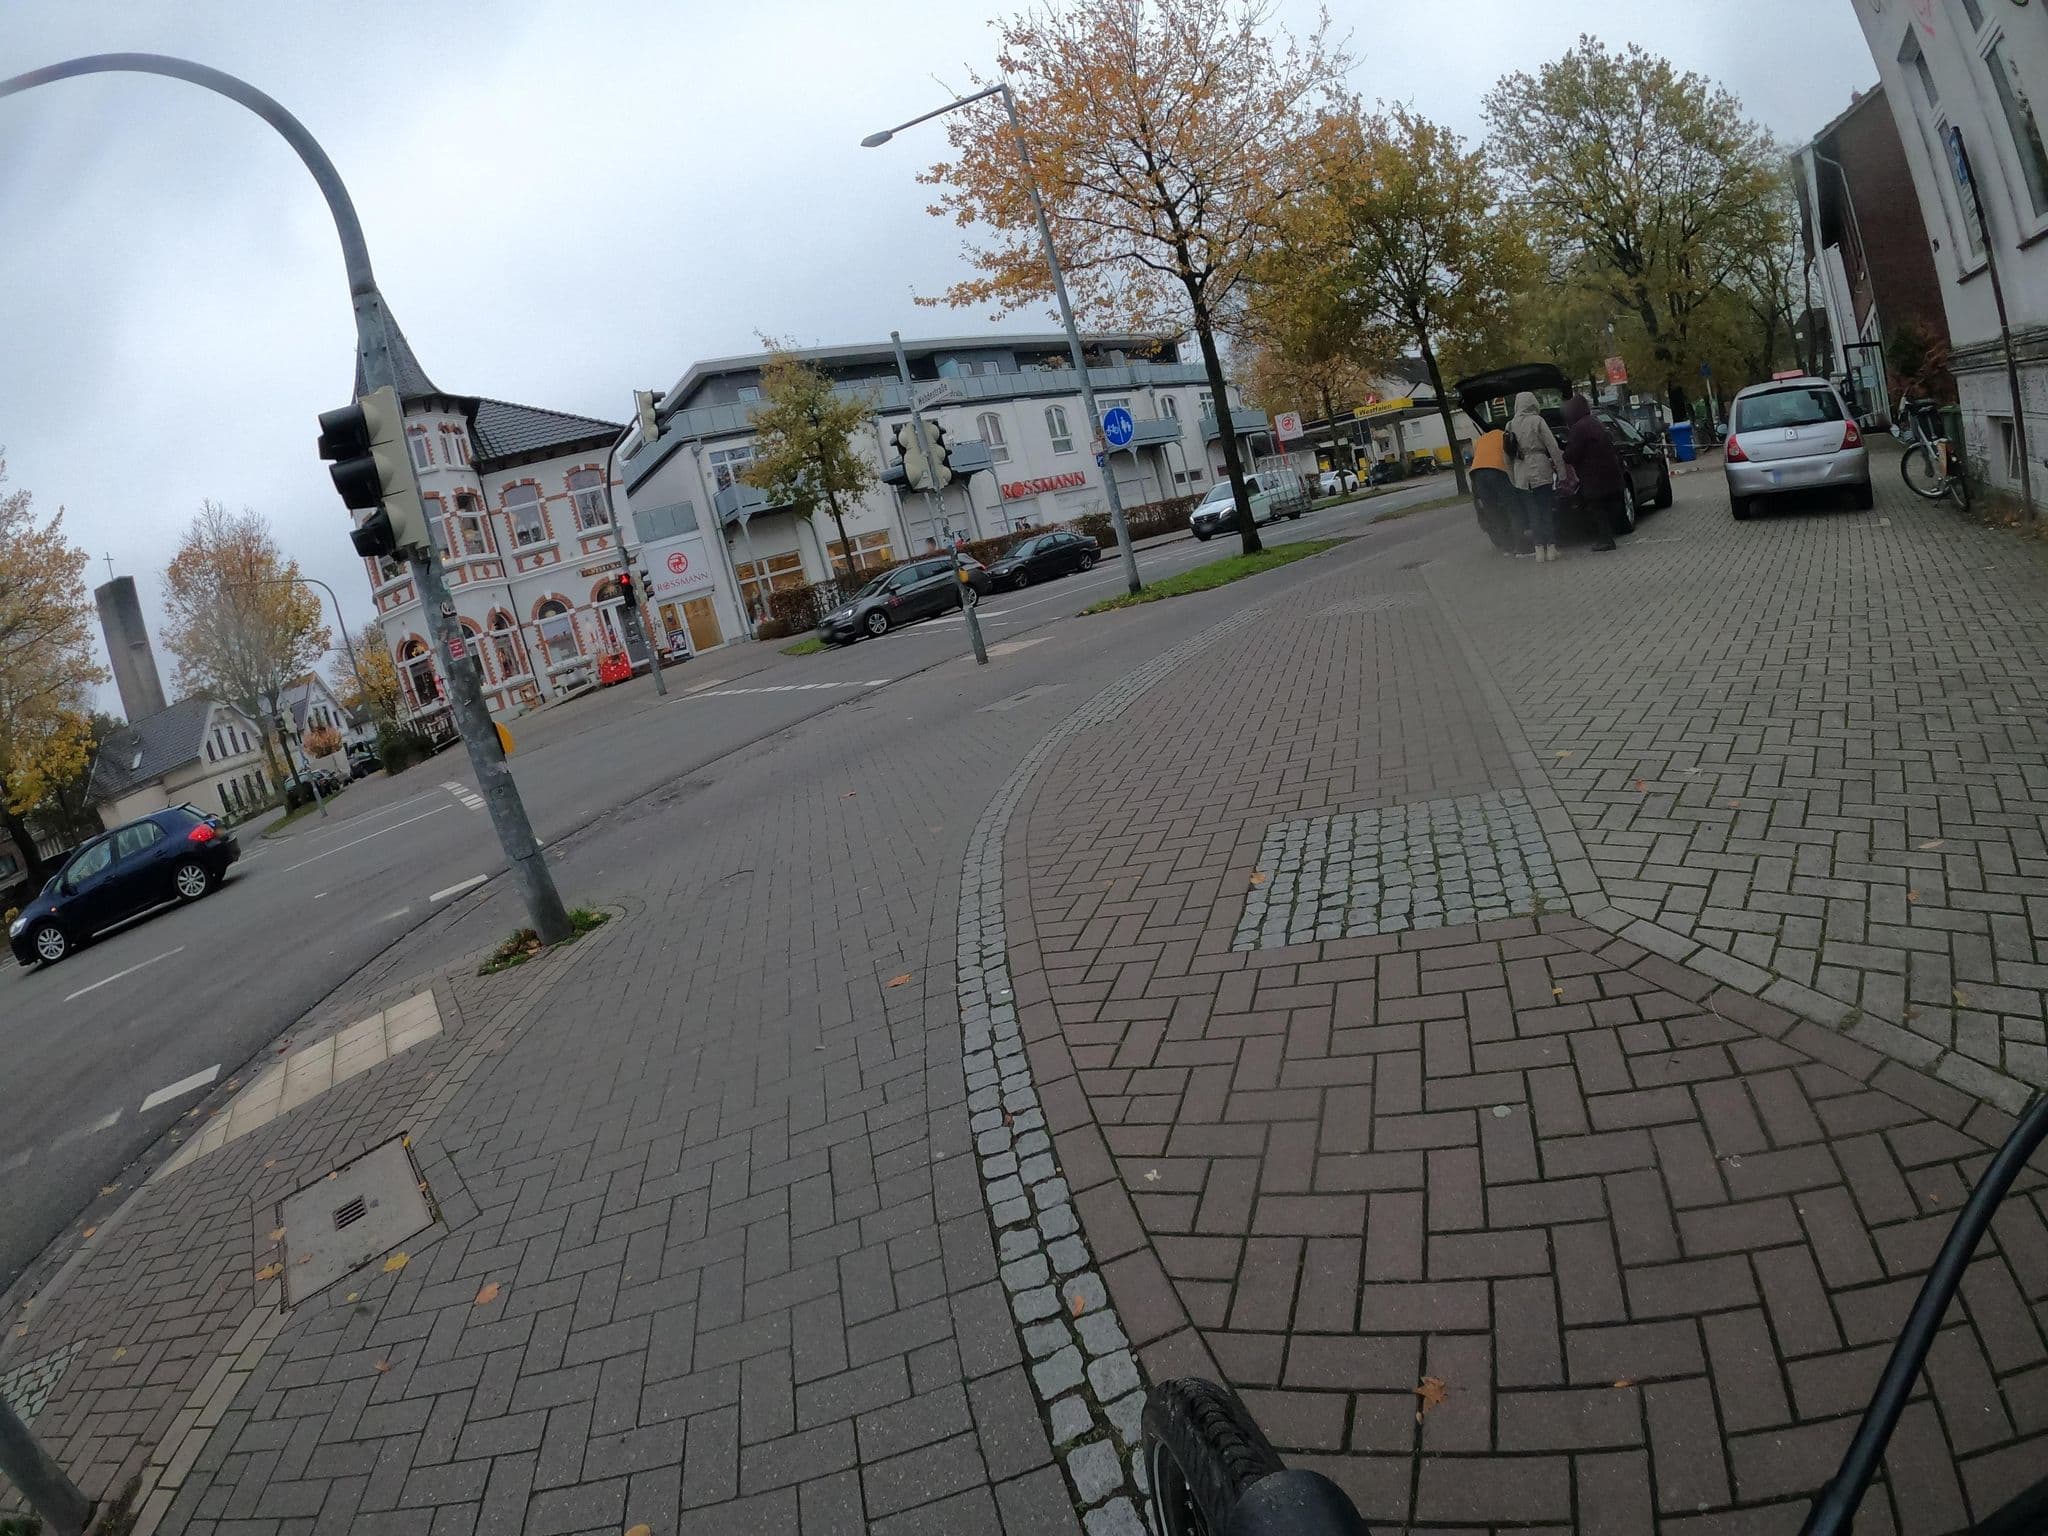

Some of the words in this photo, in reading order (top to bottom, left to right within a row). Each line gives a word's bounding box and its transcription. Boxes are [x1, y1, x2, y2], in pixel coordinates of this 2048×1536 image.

[1360, 404, 1393, 417] Westfalen
[1001, 470, 1086, 499] ROSSMANN
[656, 571, 709, 592] ROSSMANN
